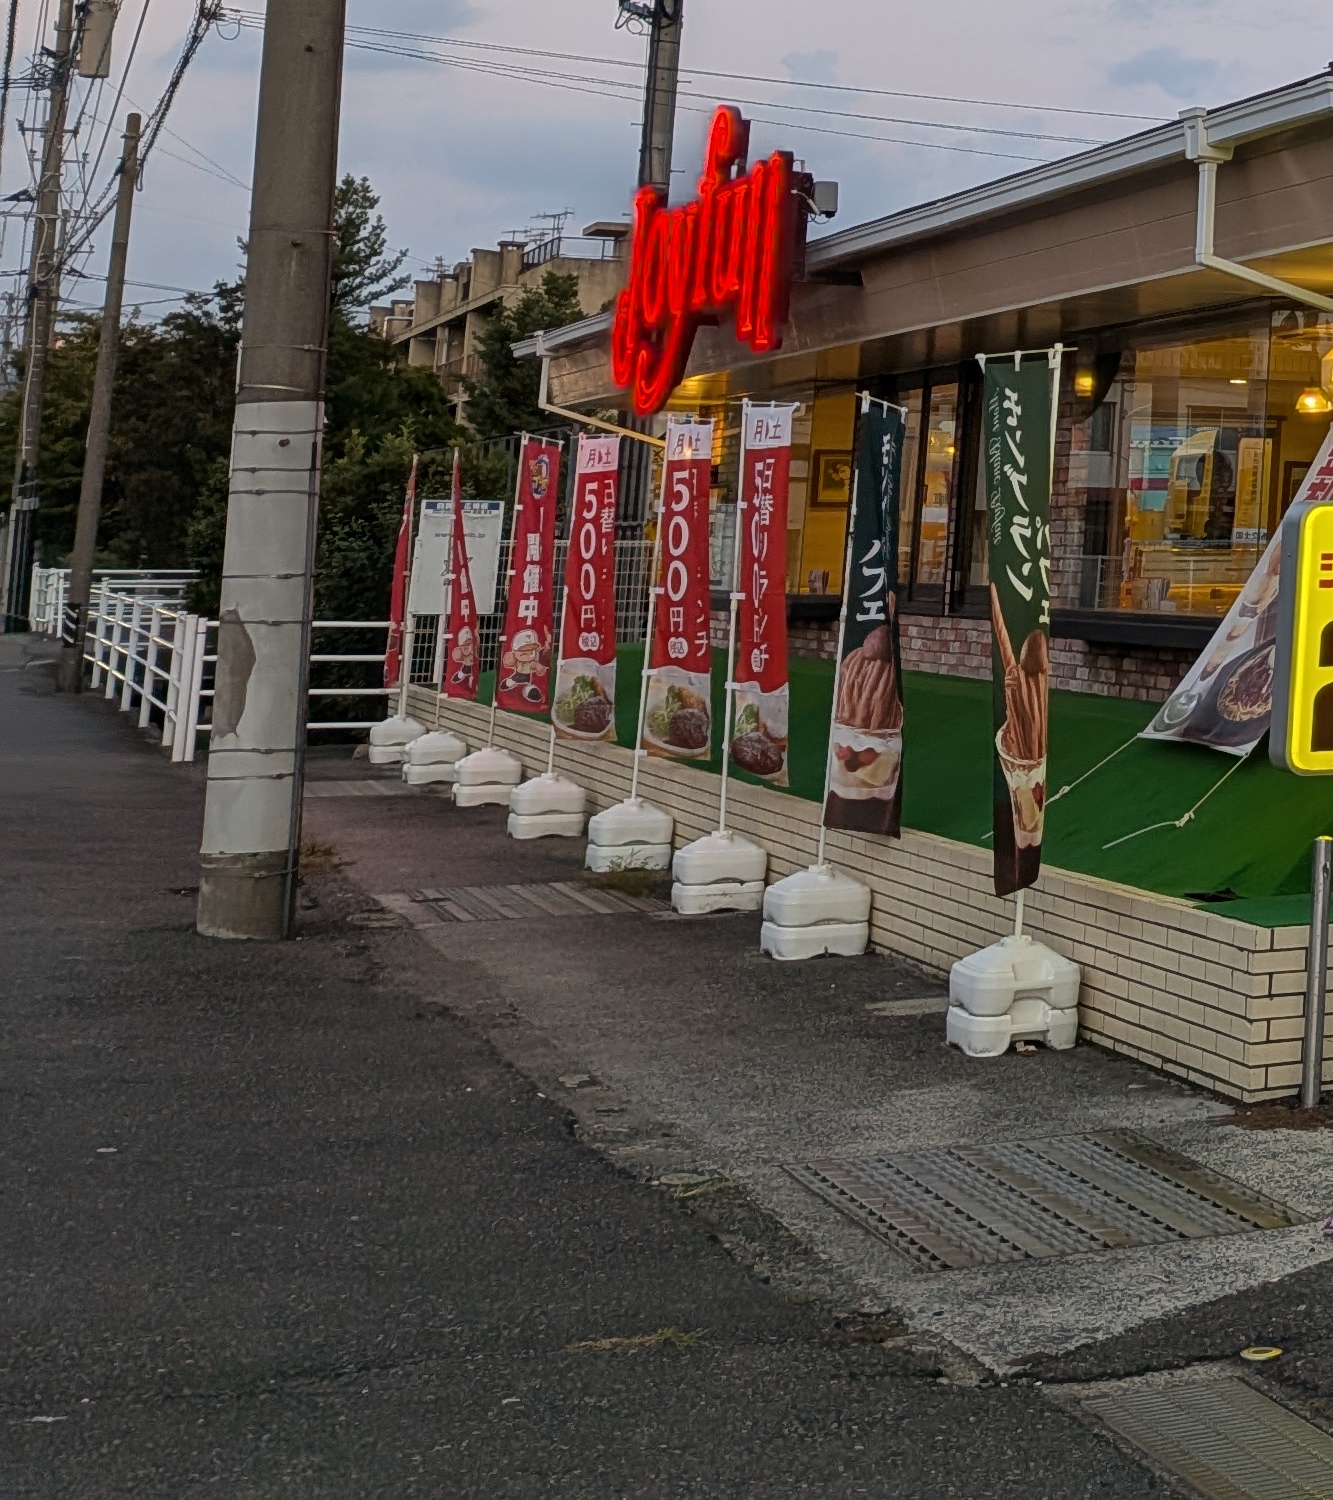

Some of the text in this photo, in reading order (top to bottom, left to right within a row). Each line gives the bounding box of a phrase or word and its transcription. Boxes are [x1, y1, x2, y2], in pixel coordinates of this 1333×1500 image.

[612, 105, 786, 416] Joyfull
[579, 481, 599, 628] 500円
[666, 469, 690, 632] 500円
